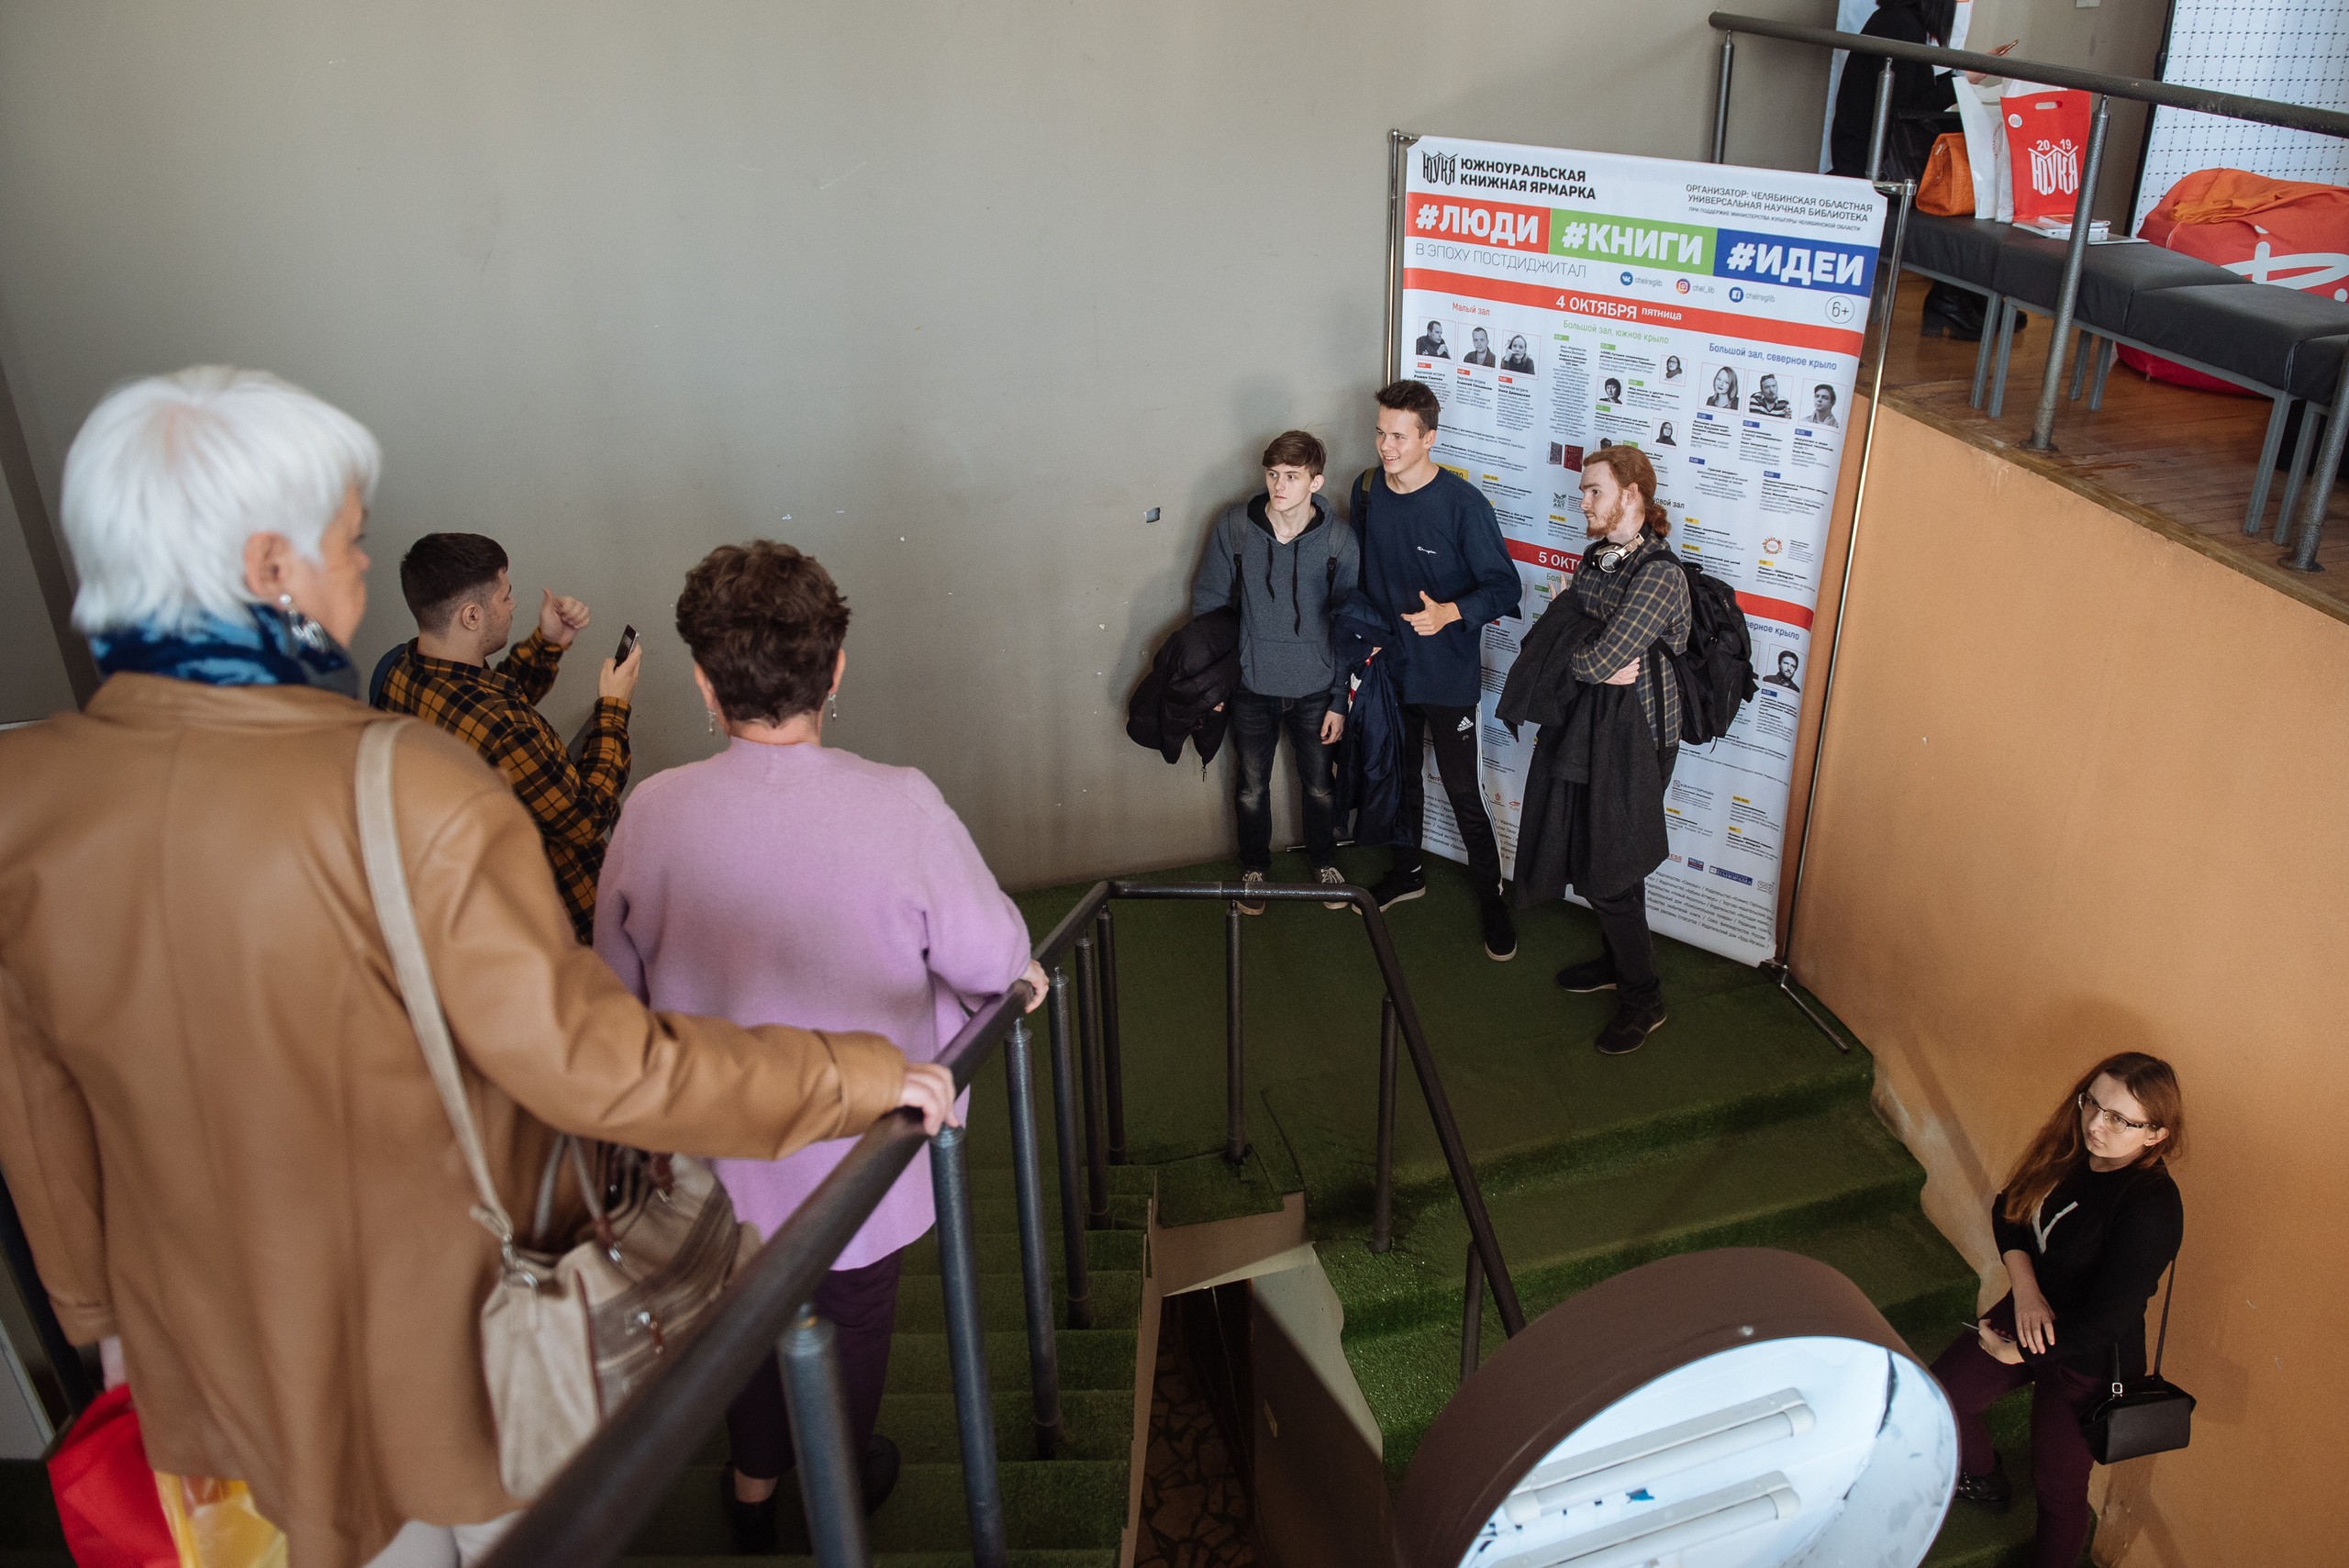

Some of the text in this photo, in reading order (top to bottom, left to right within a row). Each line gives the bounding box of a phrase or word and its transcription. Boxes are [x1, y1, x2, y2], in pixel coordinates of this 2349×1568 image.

[2036, 139, 2072, 151] 20 19
[1461, 158, 1586, 182] ЮЖНОУРАЛЬСКАЯ
[1461, 173, 1596, 200] КНИЖНАЯ ЯРМАРКА
[1686, 183, 1873, 213] ОРГАНИЗАТОР: ЧЕЛЯБИНСКАЯ ОБЛАСТНАЯ
[1688, 195, 1868, 222] УНИВЕРСАЛЬНАЯ НАУЧНАЯ БИБЛИОТЕКА
[1699, 208, 1730, 217] ПОДДЕРЖКЕ
[1731, 212, 1770, 221] МИНИСТЕРСТВА
[1798, 219, 1836, 229] ЧЕЛЯБИНСКОЙ
[1416, 204, 1538, 246] #ЛЮДИ
[1562, 222, 1703, 265] #КНИГИ
[1416, 243, 1586, 278] В ЭПОХУ ПОСТДИДЖИТАЛ
[1726, 242, 1865, 286] #ИДЕИ
[1635, 276, 1663, 287] chelreglib
[1556, 295, 1682, 320] 4 ОКТЯБРЯ пятница
[1745, 289, 1775, 303] chelreglib
[1453, 303, 1475, 314] Малый
[1831, 301, 1850, 317] 6+
[1564, 320, 1669, 345] Большой зал, южное крыло
[1709, 343, 1837, 371] Большой зал, северное крыло
[1652, 497, 1685, 509] овой зал
[1538, 551, 1547, 563] 5
[1745, 620, 1800, 640] верное крыло
